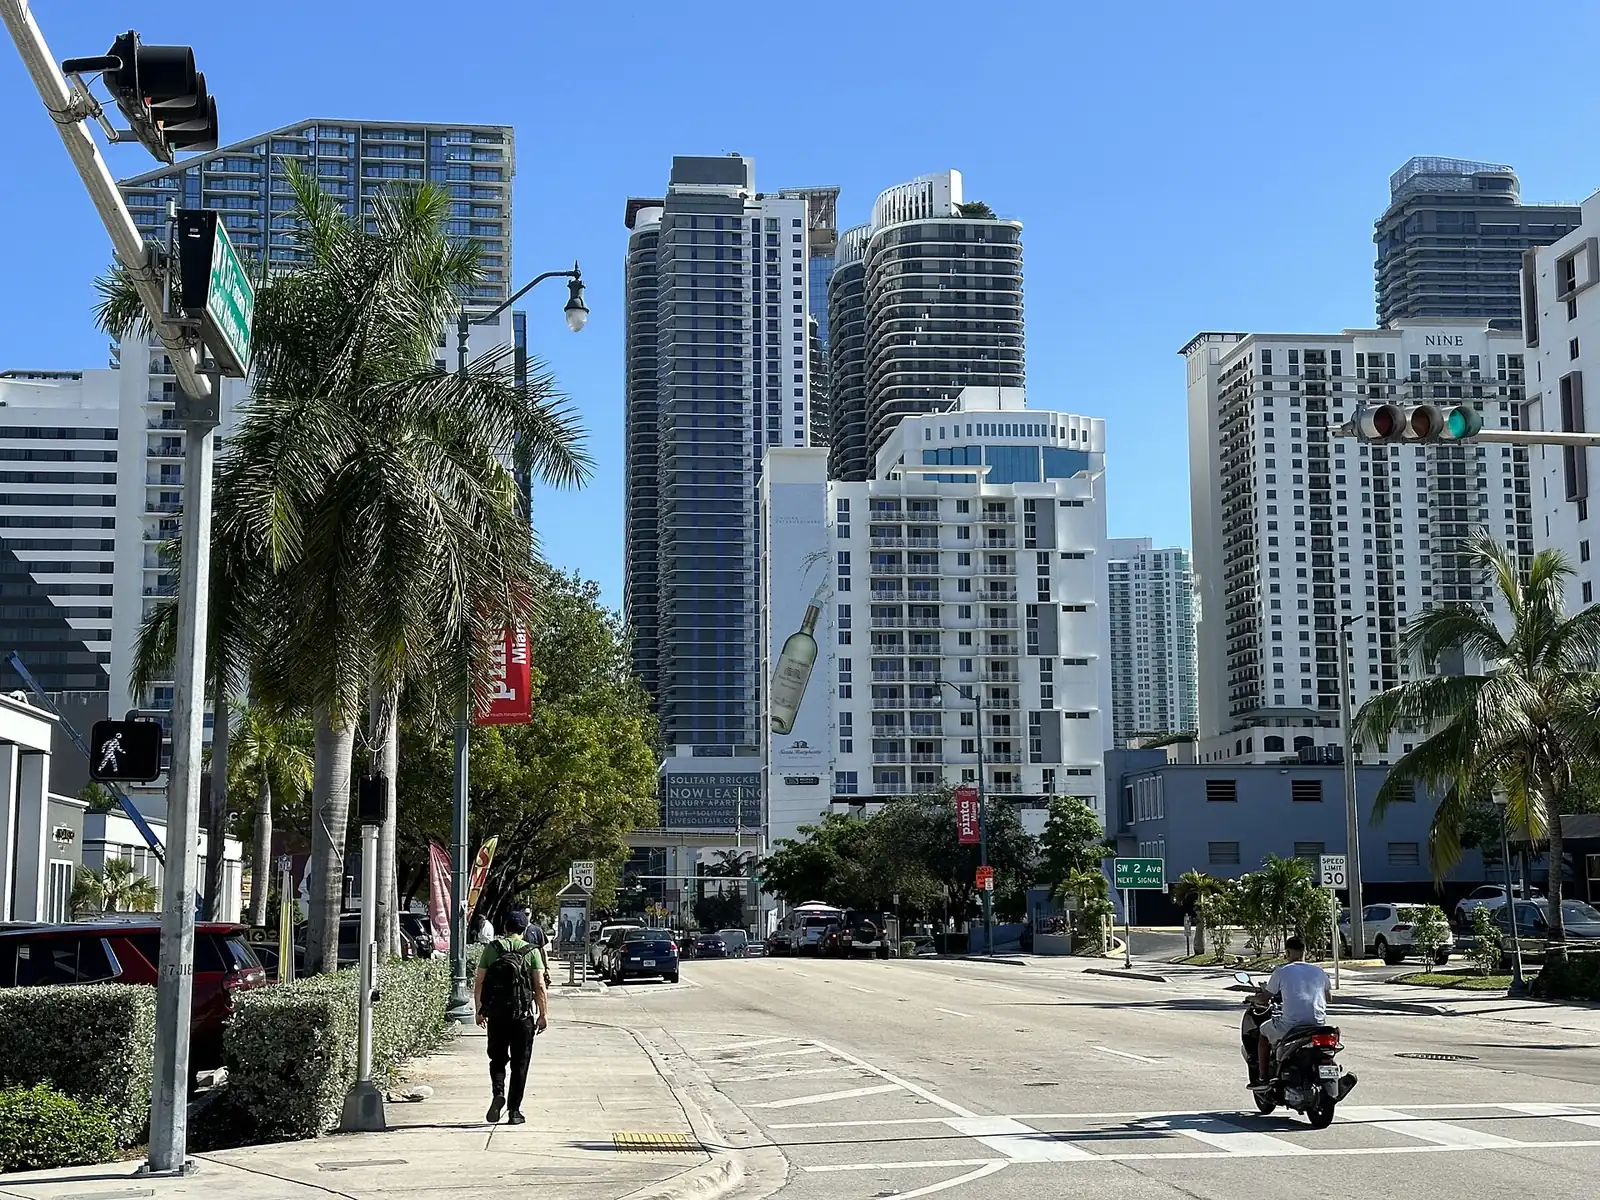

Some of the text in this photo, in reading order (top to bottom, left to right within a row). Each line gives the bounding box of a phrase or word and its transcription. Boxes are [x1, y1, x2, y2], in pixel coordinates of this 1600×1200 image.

[1425, 335, 1464, 346] NINE
[670, 776, 716, 784] SOLITAIR
[670, 788, 704, 799] NOW
[959, 800, 974, 836] pinta
[1116, 863, 1161, 874] SW 2 Ave
[1117, 876, 1161, 884] NEXT SIGNAL
[1323, 872, 1344, 885] 30
